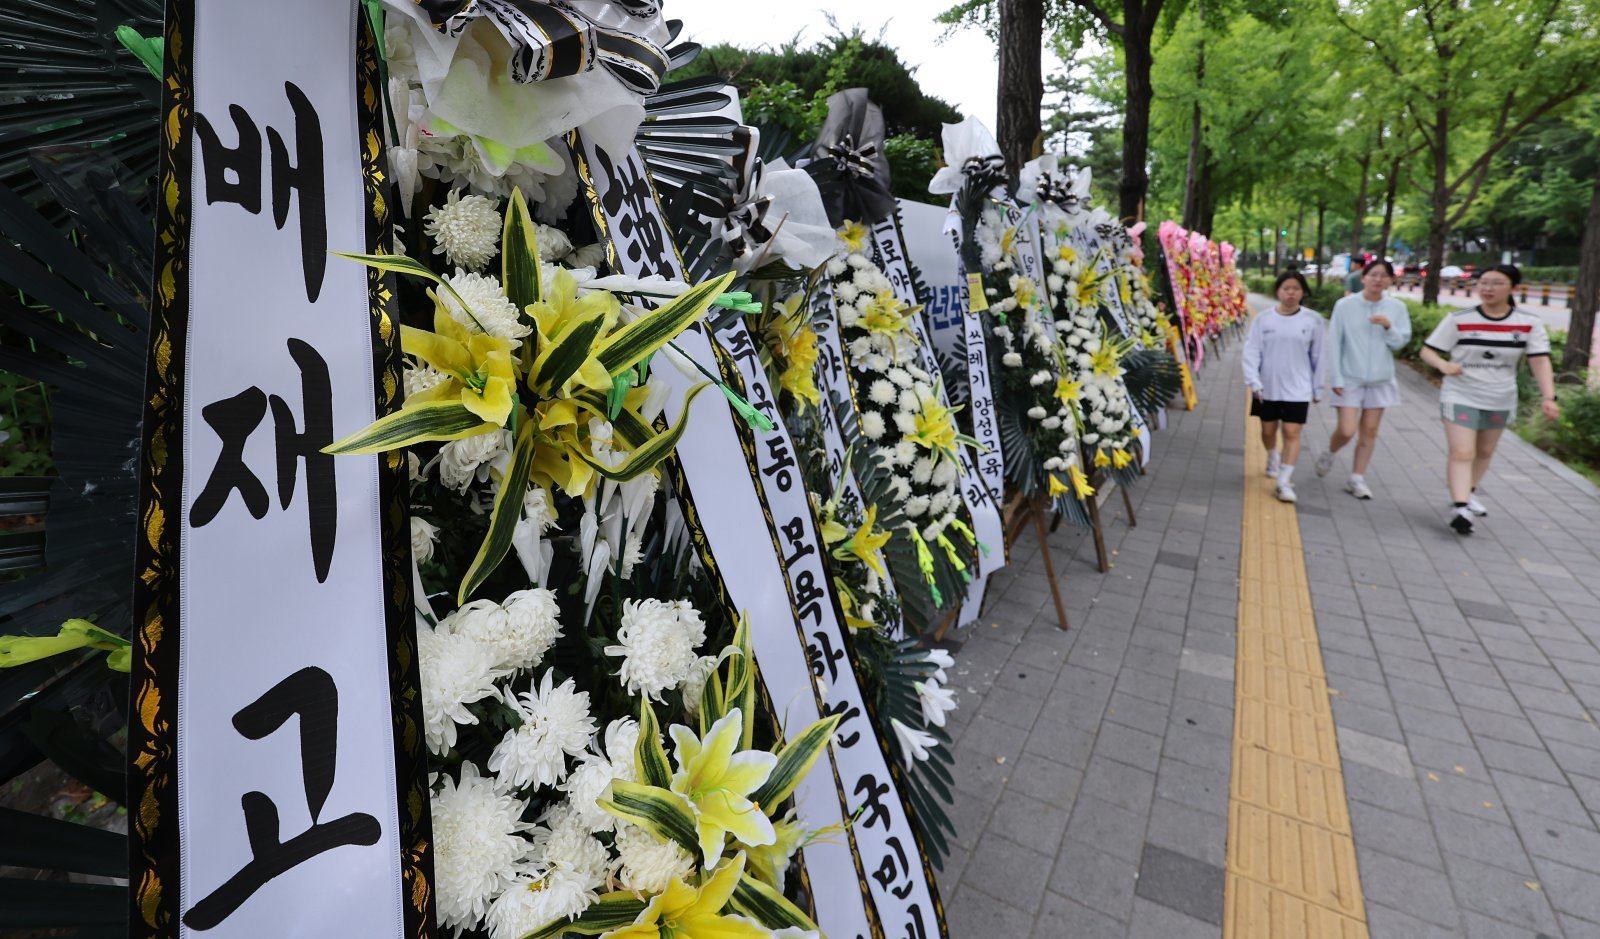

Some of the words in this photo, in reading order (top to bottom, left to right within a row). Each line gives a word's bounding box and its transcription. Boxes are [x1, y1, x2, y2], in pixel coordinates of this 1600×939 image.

[184, 81, 381, 931] 배재고
[725, 320, 795, 492] 주운동
[781, 516, 860, 749] 모욕하는
[968, 329, 986, 388] 쓰레기
